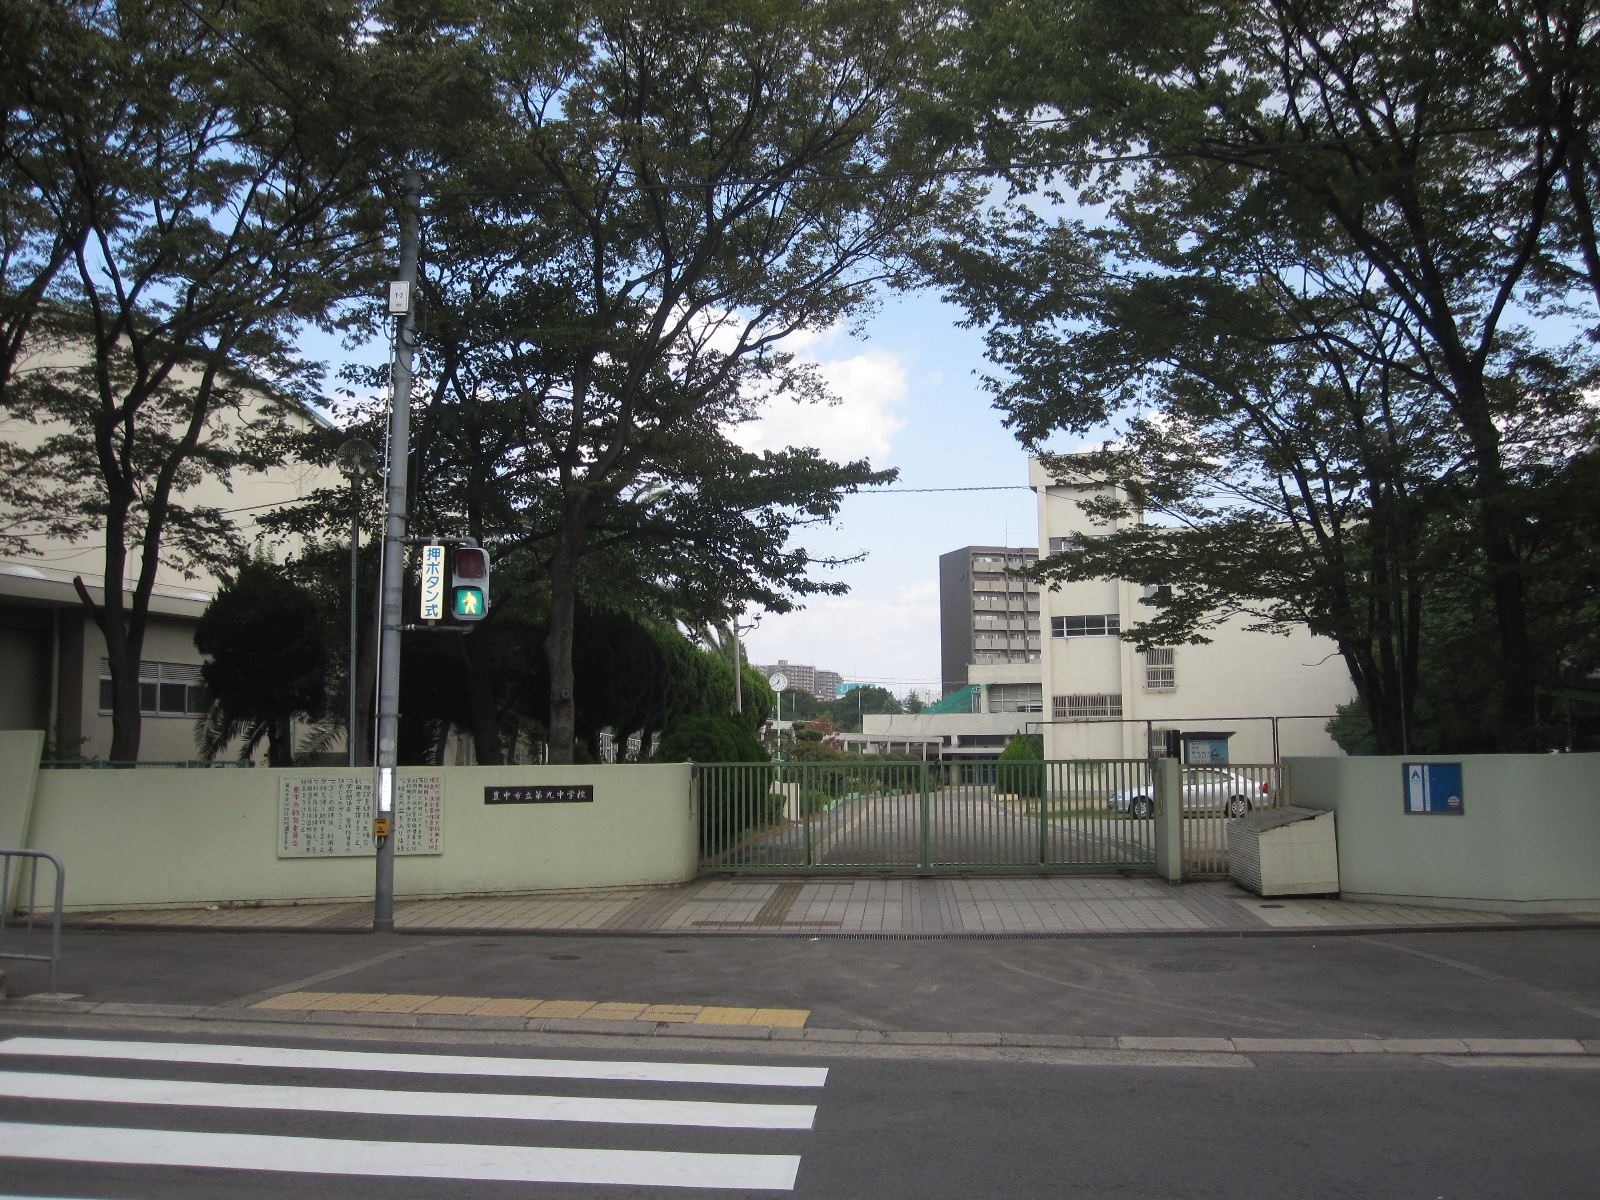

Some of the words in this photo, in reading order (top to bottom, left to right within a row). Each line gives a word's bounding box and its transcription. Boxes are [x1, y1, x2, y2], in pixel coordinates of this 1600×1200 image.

[425, 547, 441, 617] 押ボタン式
[291, 786, 301, 847] 豊中市教育委員会
[492, 789, 587, 802] 豊中市立第九中学校
